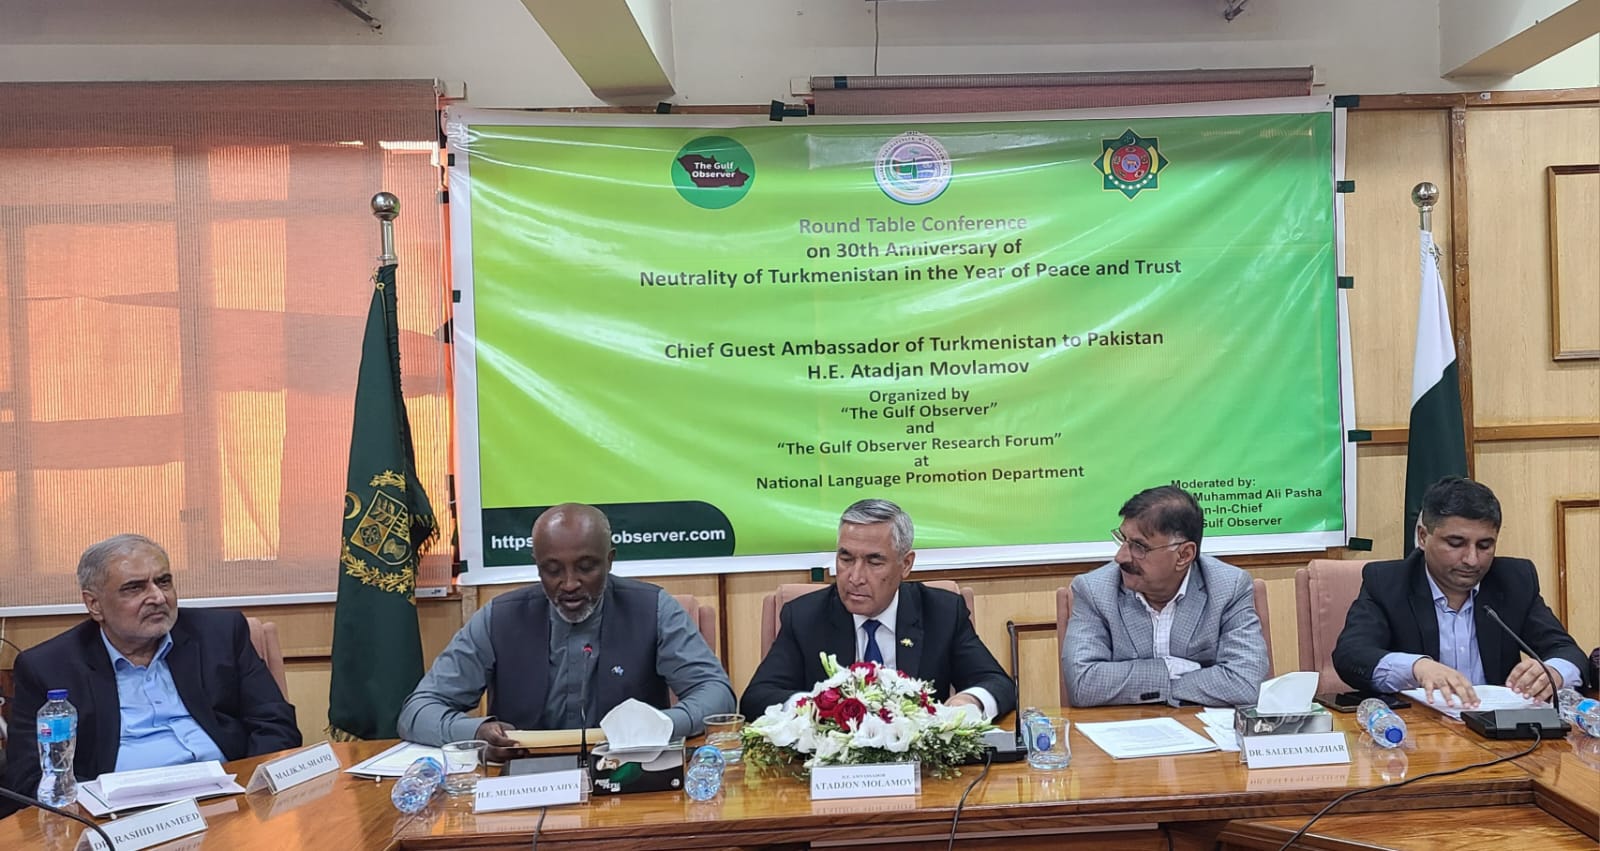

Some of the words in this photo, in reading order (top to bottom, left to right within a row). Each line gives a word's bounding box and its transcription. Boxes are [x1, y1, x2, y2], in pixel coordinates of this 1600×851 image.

[694, 162, 712, 170] The
[714, 161, 734, 170] Gulf
[692, 170, 736, 178] Observer
[800, 217, 861, 234] Round
[866, 216, 917, 233] Table
[921, 215, 1027, 232] Conference
[806, 248, 831, 258] on
[836, 242, 879, 258] 30th
[885, 240, 999, 260] Anniversary
[1003, 238, 1023, 255] of
[640, 269, 738, 288] Neutrality
[743, 268, 763, 285] of
[768, 266, 899, 284] Turkmenistan
[905, 266, 922, 281] in
[926, 264, 958, 280] the
[962, 263, 1006, 279] Year
[1011, 262, 1031, 278] of
[1036, 261, 1094, 277] Peace
[1097, 259, 1133, 276] and
[1135, 258, 1182, 275] Trust
[664, 341, 715, 360] Chief
[720, 341, 775, 358] Guest
[781, 339, 900, 356] Ambassador
[905, 337, 925, 353] of
[929, 334, 1057, 352] Turkmenistan
[1062, 333, 1082, 348] to
[1088, 329, 1164, 347] Pakistan
[808, 363, 845, 380] H.E.
[850, 361, 924, 381] Atadjan
[930, 358, 1030, 377] Movlamov
[869, 388, 947, 404] Organized
[951, 387, 970, 402] by
[883, 404, 916, 418] Gulf
[906, 421, 934, 435] and
[819, 440, 852, 455] Gulf
[856, 438, 928, 452] Observer
[932, 435, 1000, 451] Research
[914, 456, 929, 467] at
[756, 475, 823, 490] National
[828, 472, 902, 490] Language
[906, 469, 988, 486] Promotion
[992, 465, 1085, 484] Department
[1171, 478, 1234, 489] Moderated
[1237, 477, 1256, 488] by:
[1193, 491, 1263, 502] Muhammad
[1265, 489, 1281, 499] Ali
[1285, 488, 1323, 498] Pasha
[1204, 503, 1263, 514] n-In-Chief
[1227, 517, 1282, 527] Observer
[1265, 747, 1303, 755] SALEEM
[1304, 744, 1345, 754] MAZHAR
[861, 778, 914, 789] MOLAMOV
[496, 787, 549, 797] MUHAMMAD
[114, 826, 155, 845] RASHID
[156, 812, 200, 832] HAMEED
